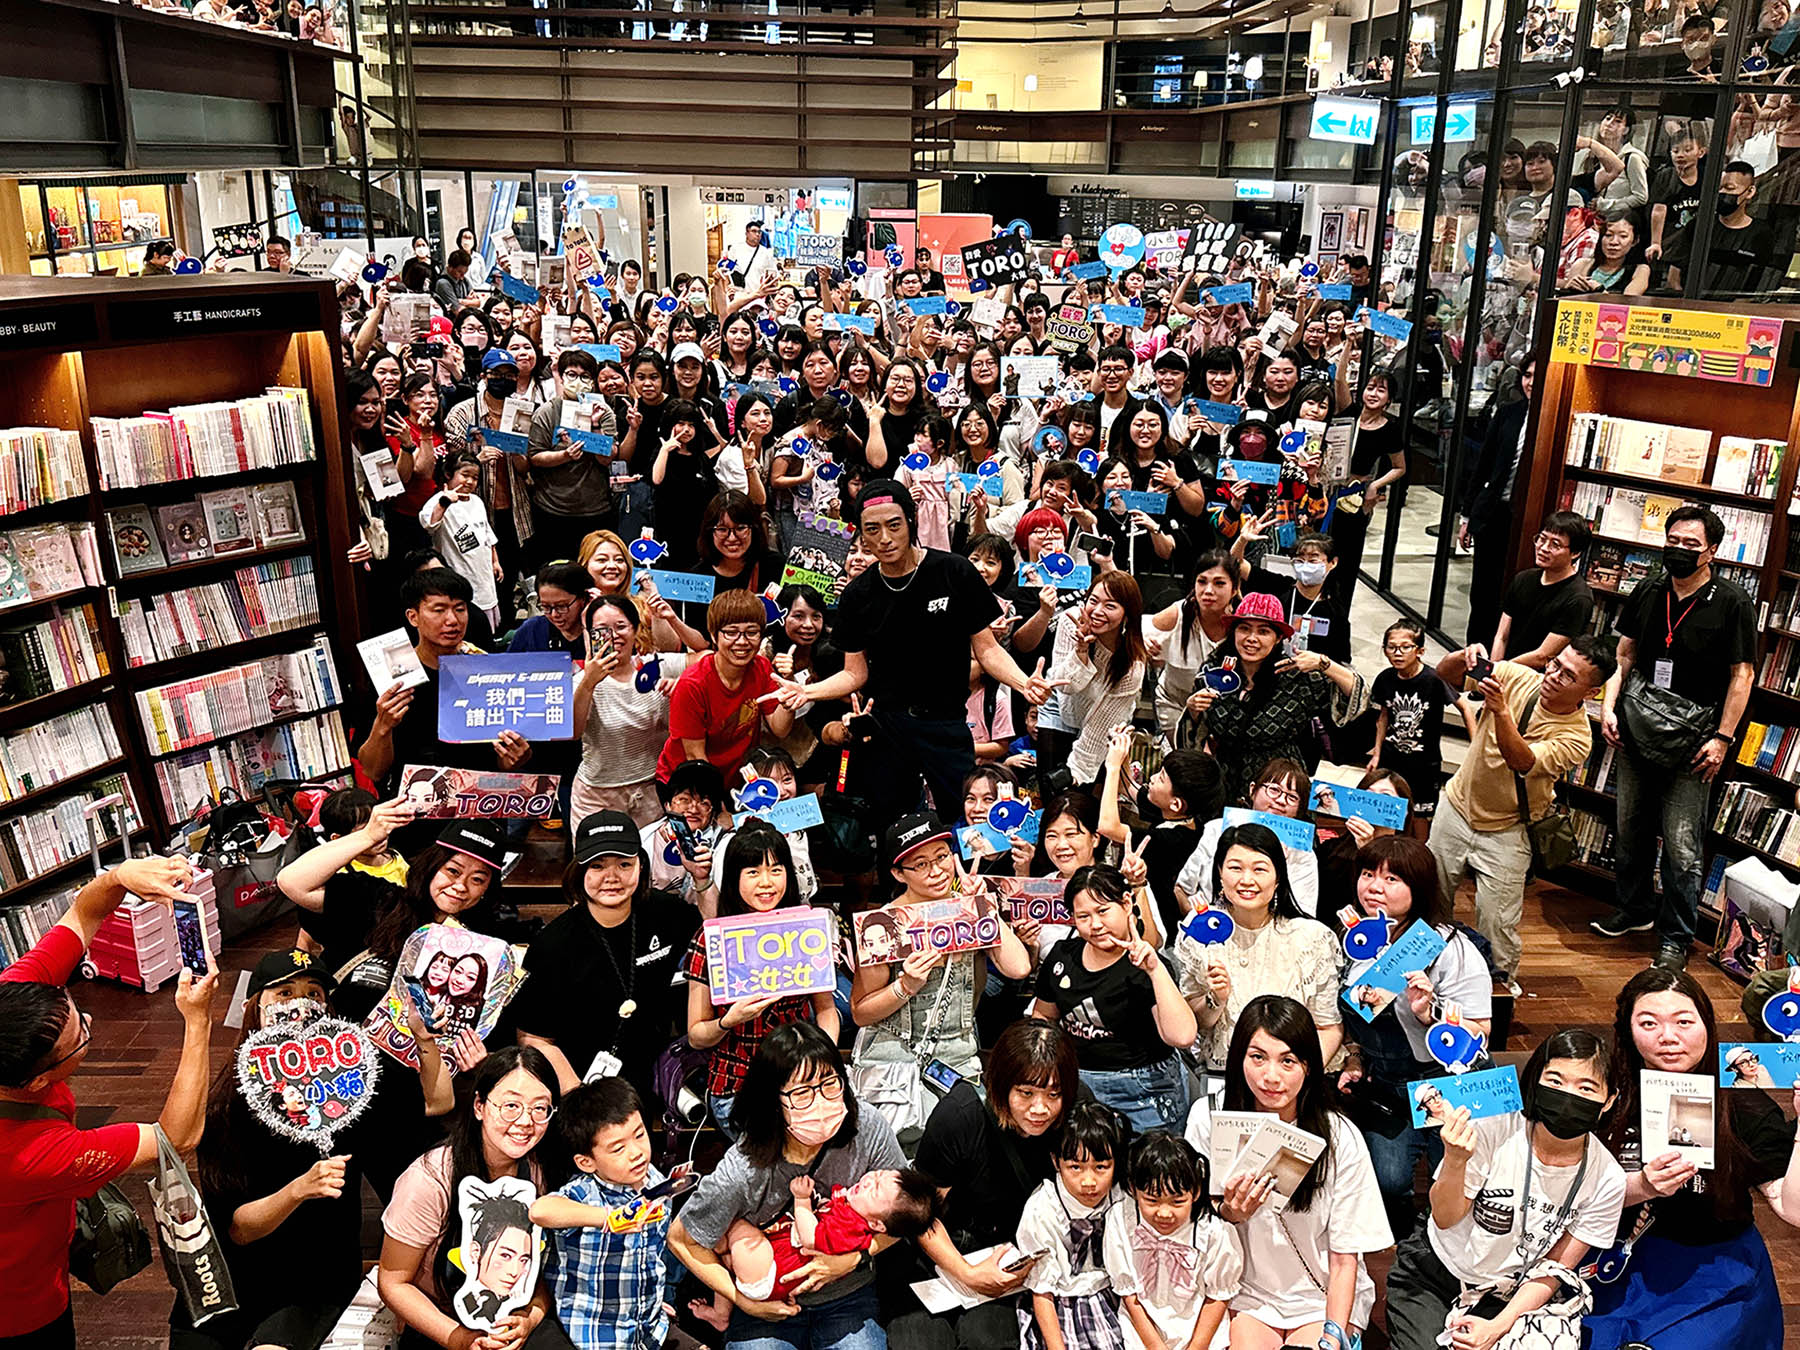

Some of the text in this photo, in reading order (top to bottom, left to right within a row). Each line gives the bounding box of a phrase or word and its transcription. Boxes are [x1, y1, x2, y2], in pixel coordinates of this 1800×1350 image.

[801, 235, 837, 249] TORO
[1196, 223, 1236, 241] TORO
[966, 252, 1025, 280] TORO
[1156, 251, 1182, 264] TOR
[204, 308, 262, 320] HANDICRAFTS
[22, 321, 57, 334] BEAUTY
[1049, 321, 1089, 340] TORO
[1556, 310, 1573, 347] 文化幣
[485, 685, 565, 707] 我們一起
[465, 705, 565, 728] 譜出下一曲
[455, 793, 553, 815] TORO
[1006, 896, 1073, 921] TOR
[905, 917, 999, 951] TORO
[724, 927, 828, 964] Toro
[249, 1032, 362, 1082] TORO
[194, 1253, 222, 1308] Roots
